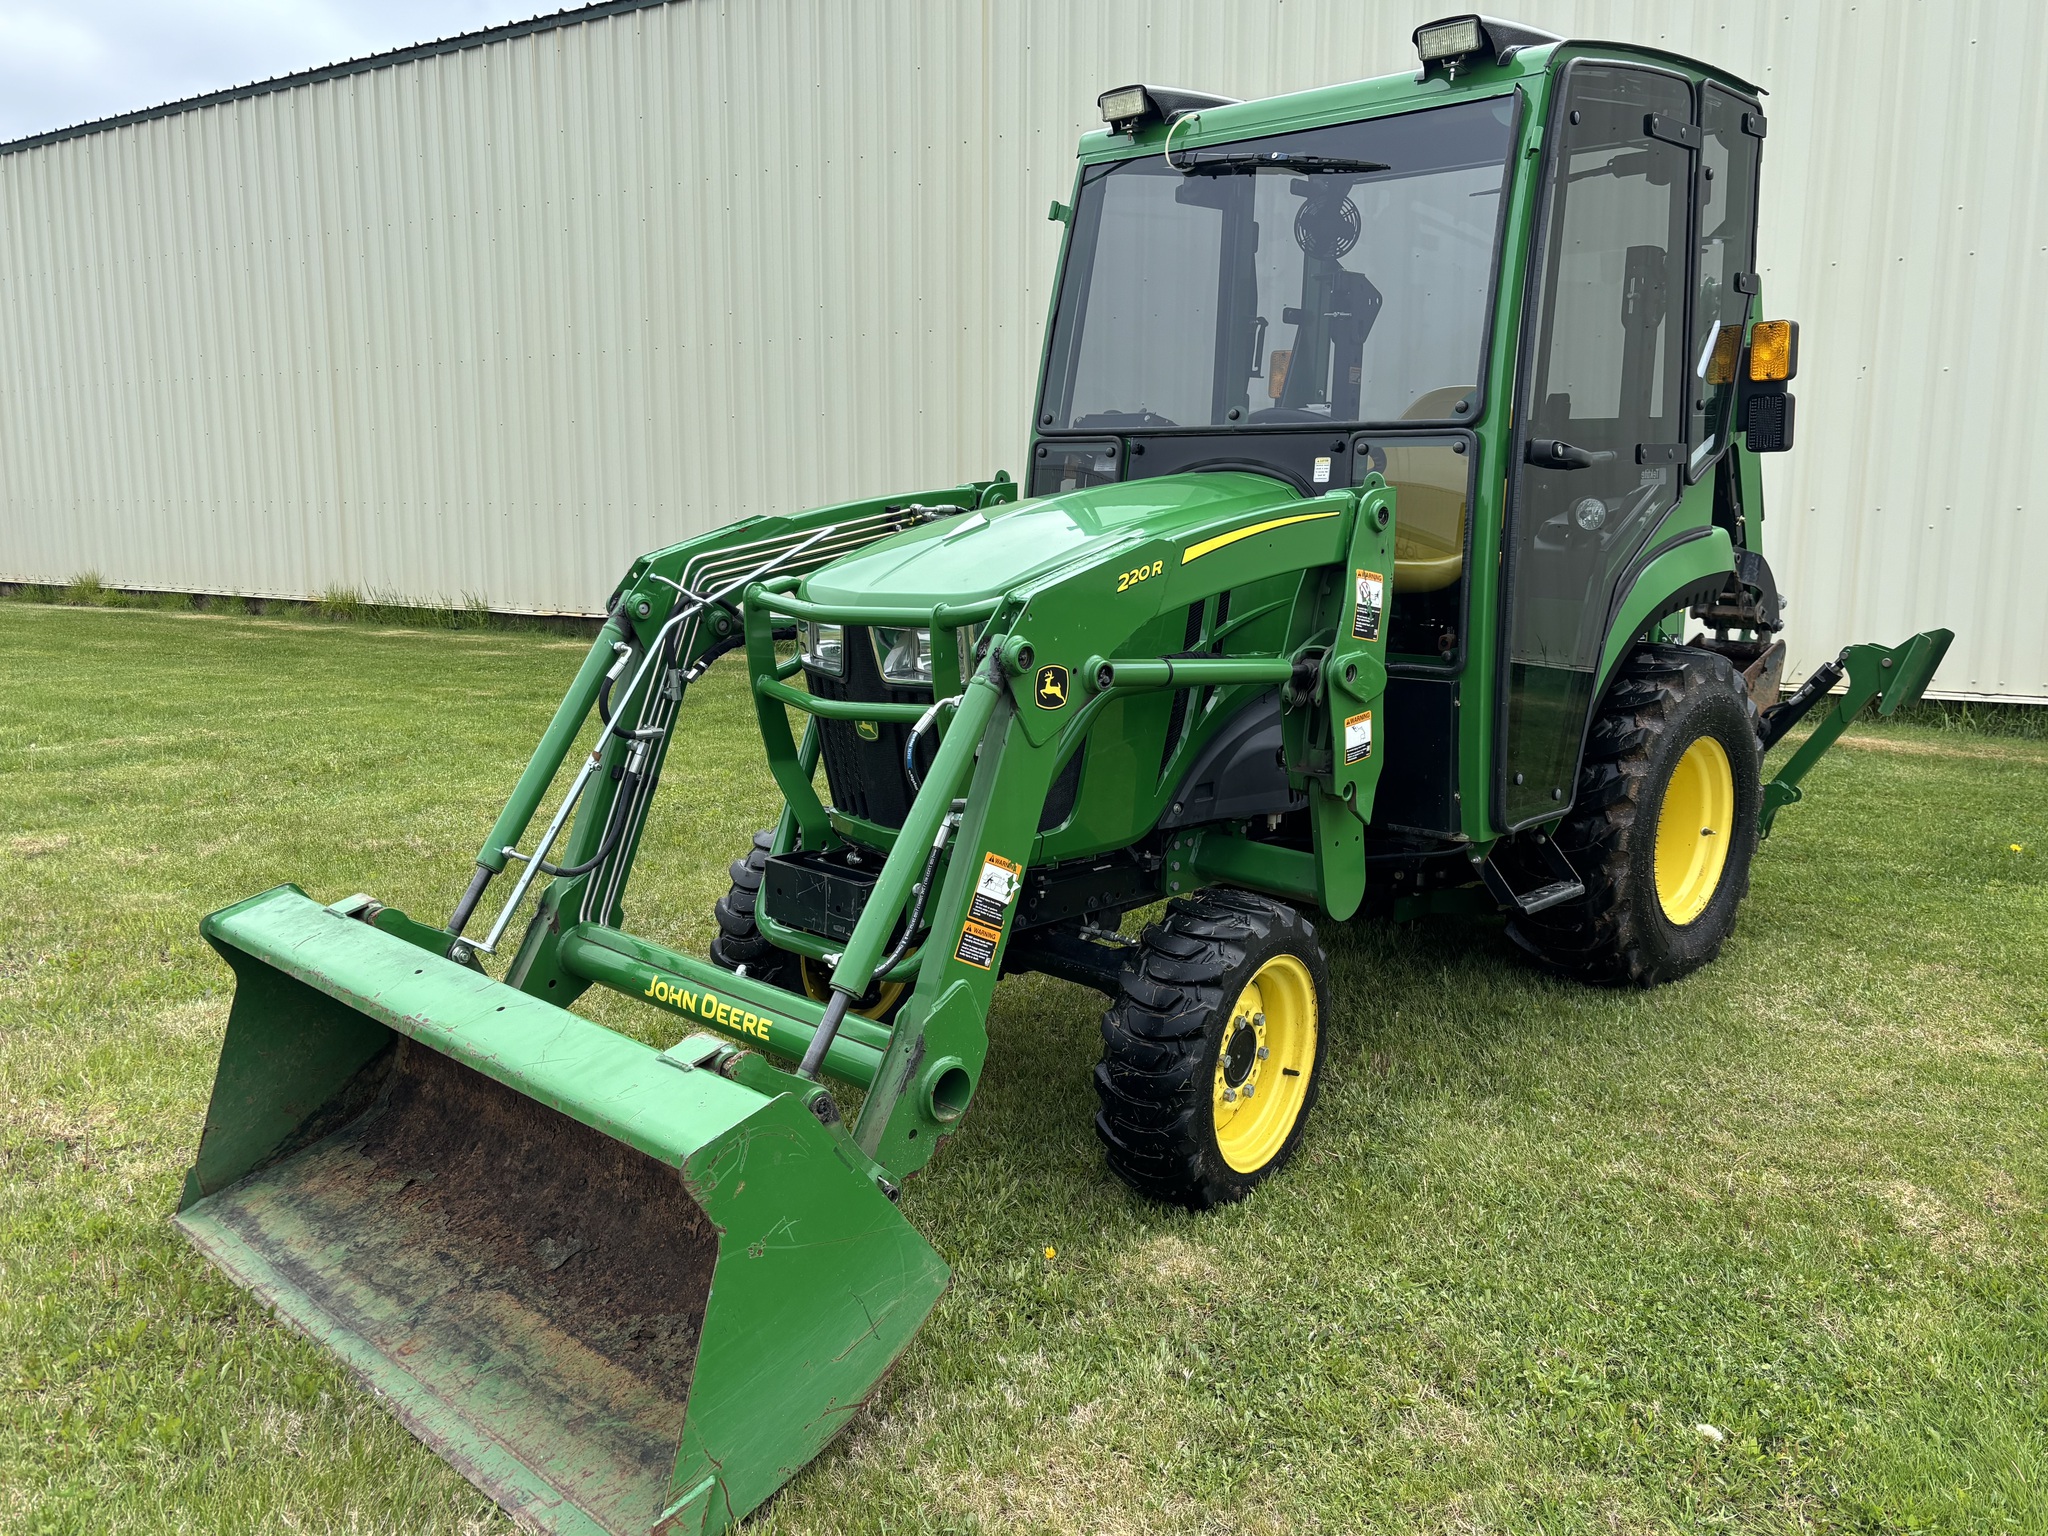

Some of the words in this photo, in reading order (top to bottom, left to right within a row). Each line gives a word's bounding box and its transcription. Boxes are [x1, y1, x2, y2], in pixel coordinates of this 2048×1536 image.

[1350, 712, 1371, 724] WARNING
[973, 927, 996, 940] WARNING
[644, 974, 698, 1013] JOHN
[701, 993, 773, 1041] DEERE
